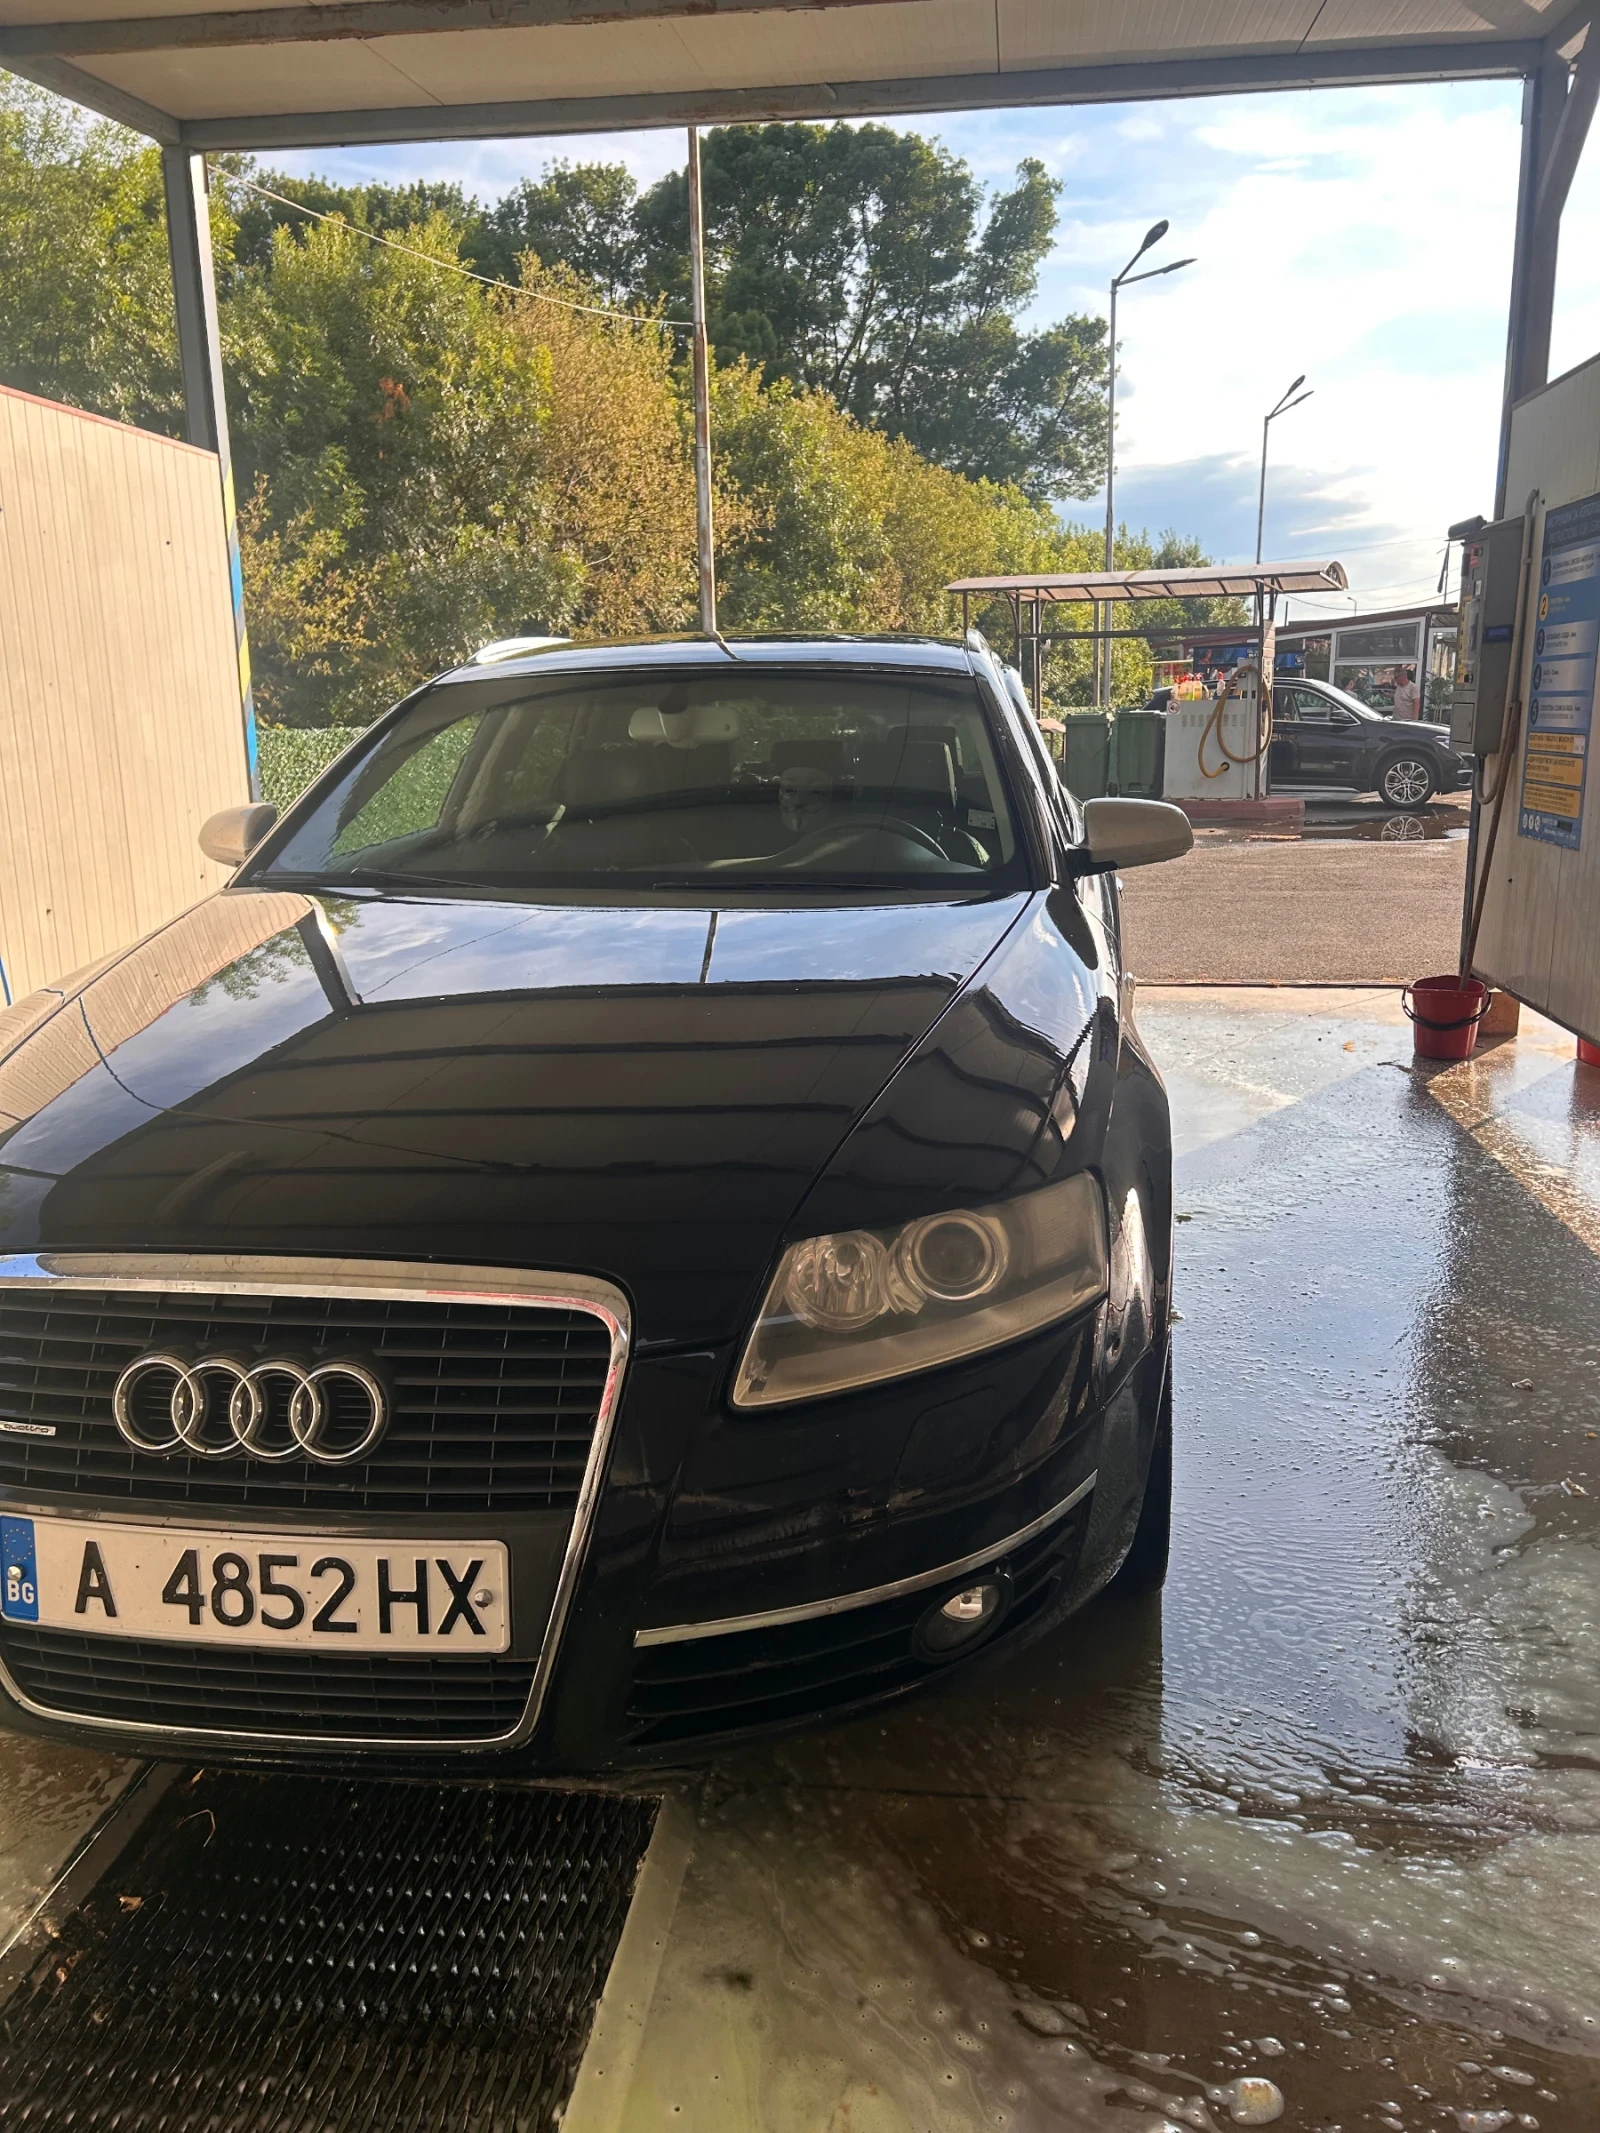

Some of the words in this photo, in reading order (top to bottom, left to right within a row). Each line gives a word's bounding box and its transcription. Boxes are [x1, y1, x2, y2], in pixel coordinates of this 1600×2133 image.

[1541, 597, 1547, 615] 2
[3, 1423, 49, 1434] quattro
[7, 1579, 35, 1604] BG
[74, 1540, 117, 1618] A
[161, 1549, 358, 1634] 4852
[376, 1558, 487, 1635] HX
